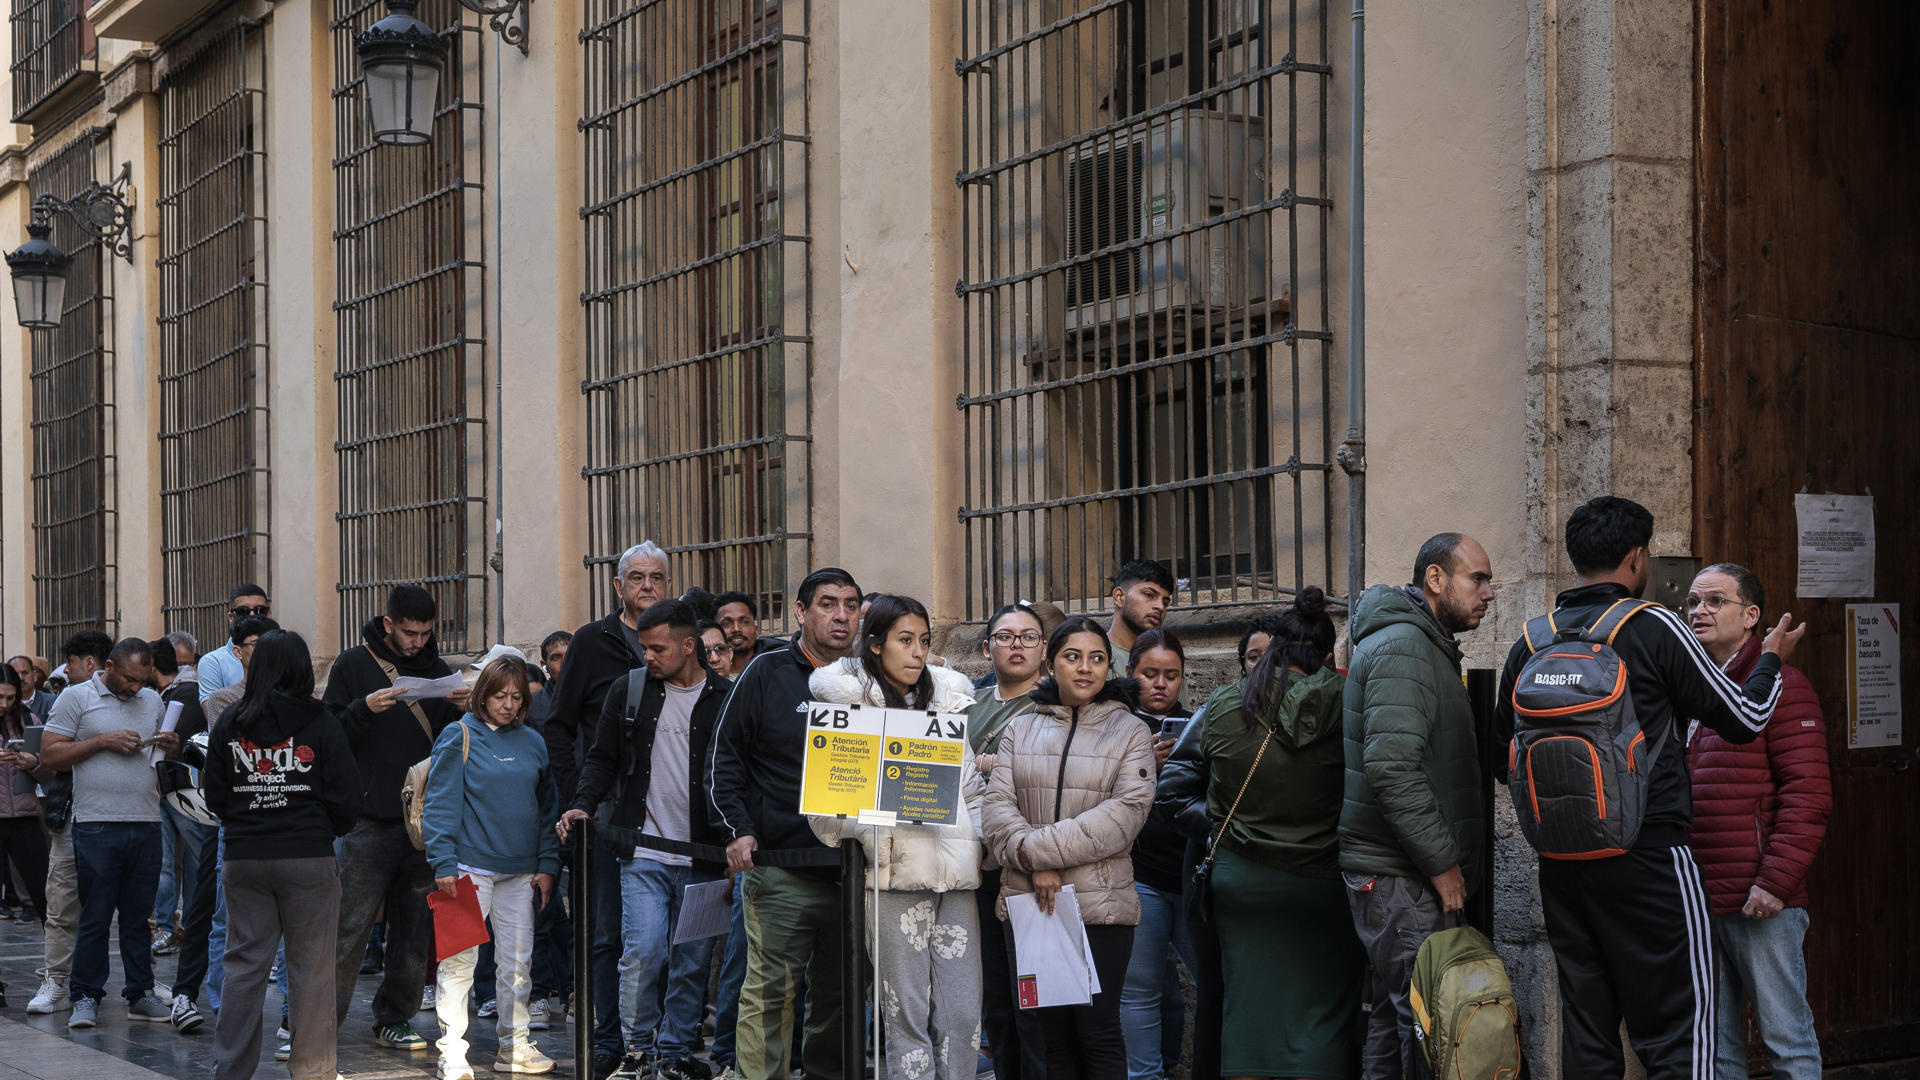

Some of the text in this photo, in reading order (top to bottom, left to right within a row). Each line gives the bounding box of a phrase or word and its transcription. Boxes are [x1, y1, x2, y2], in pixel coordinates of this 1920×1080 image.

[1871, 616, 1879, 625] de
[1858, 650, 1881, 658] basuras
[1534, 673, 1583, 685] BASIC-FIT
[833, 710, 849, 729] B
[925, 718, 943, 738] A
[832, 736, 868, 746] Atención
[909, 741, 938, 751] Padrón
[832, 744, 870, 754] Tributaria
[908, 750, 932, 758] Padró
[830, 765, 861, 775] Atenció
[889, 767, 898, 778] 2
[906, 765, 930, 773] Registro
[829, 773, 868, 783] Tributària
[920, 796, 938, 804] digital
